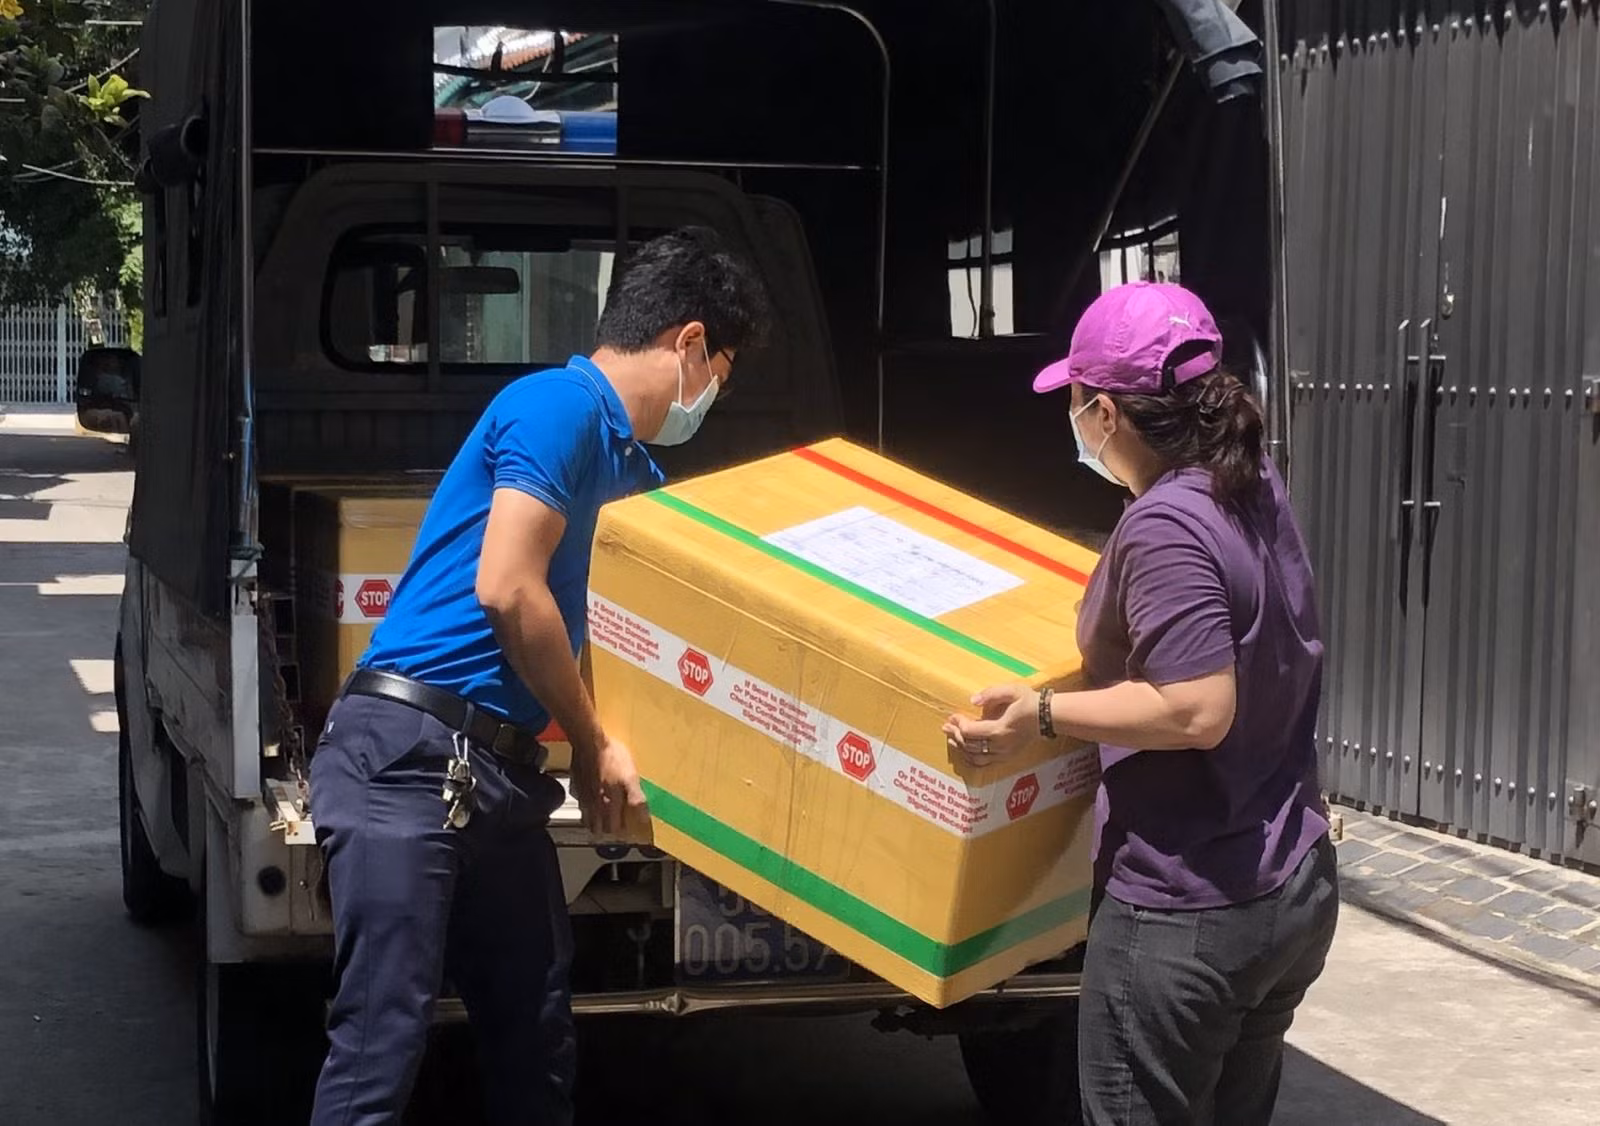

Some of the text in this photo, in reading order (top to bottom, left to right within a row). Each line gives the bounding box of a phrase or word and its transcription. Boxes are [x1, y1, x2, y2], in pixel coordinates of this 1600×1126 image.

[361, 591, 391, 606] STOP
[681, 659, 709, 684] STOP
[730, 692, 753, 710] Check
[756, 706, 790, 730] Contents
[745, 689, 777, 712] Package
[842, 743, 870, 769] STOP
[893, 778, 919, 797] Check
[921, 793, 959, 818] Contents
[898, 770, 908, 780] Or
[910, 776, 946, 800] Package
[918, 770, 937, 785] Seal
[938, 780, 946, 790] Is
[948, 786, 980, 803] Broken
[1009, 787, 1035, 808] STOP
[907, 796, 973, 833] Signing Receipt
